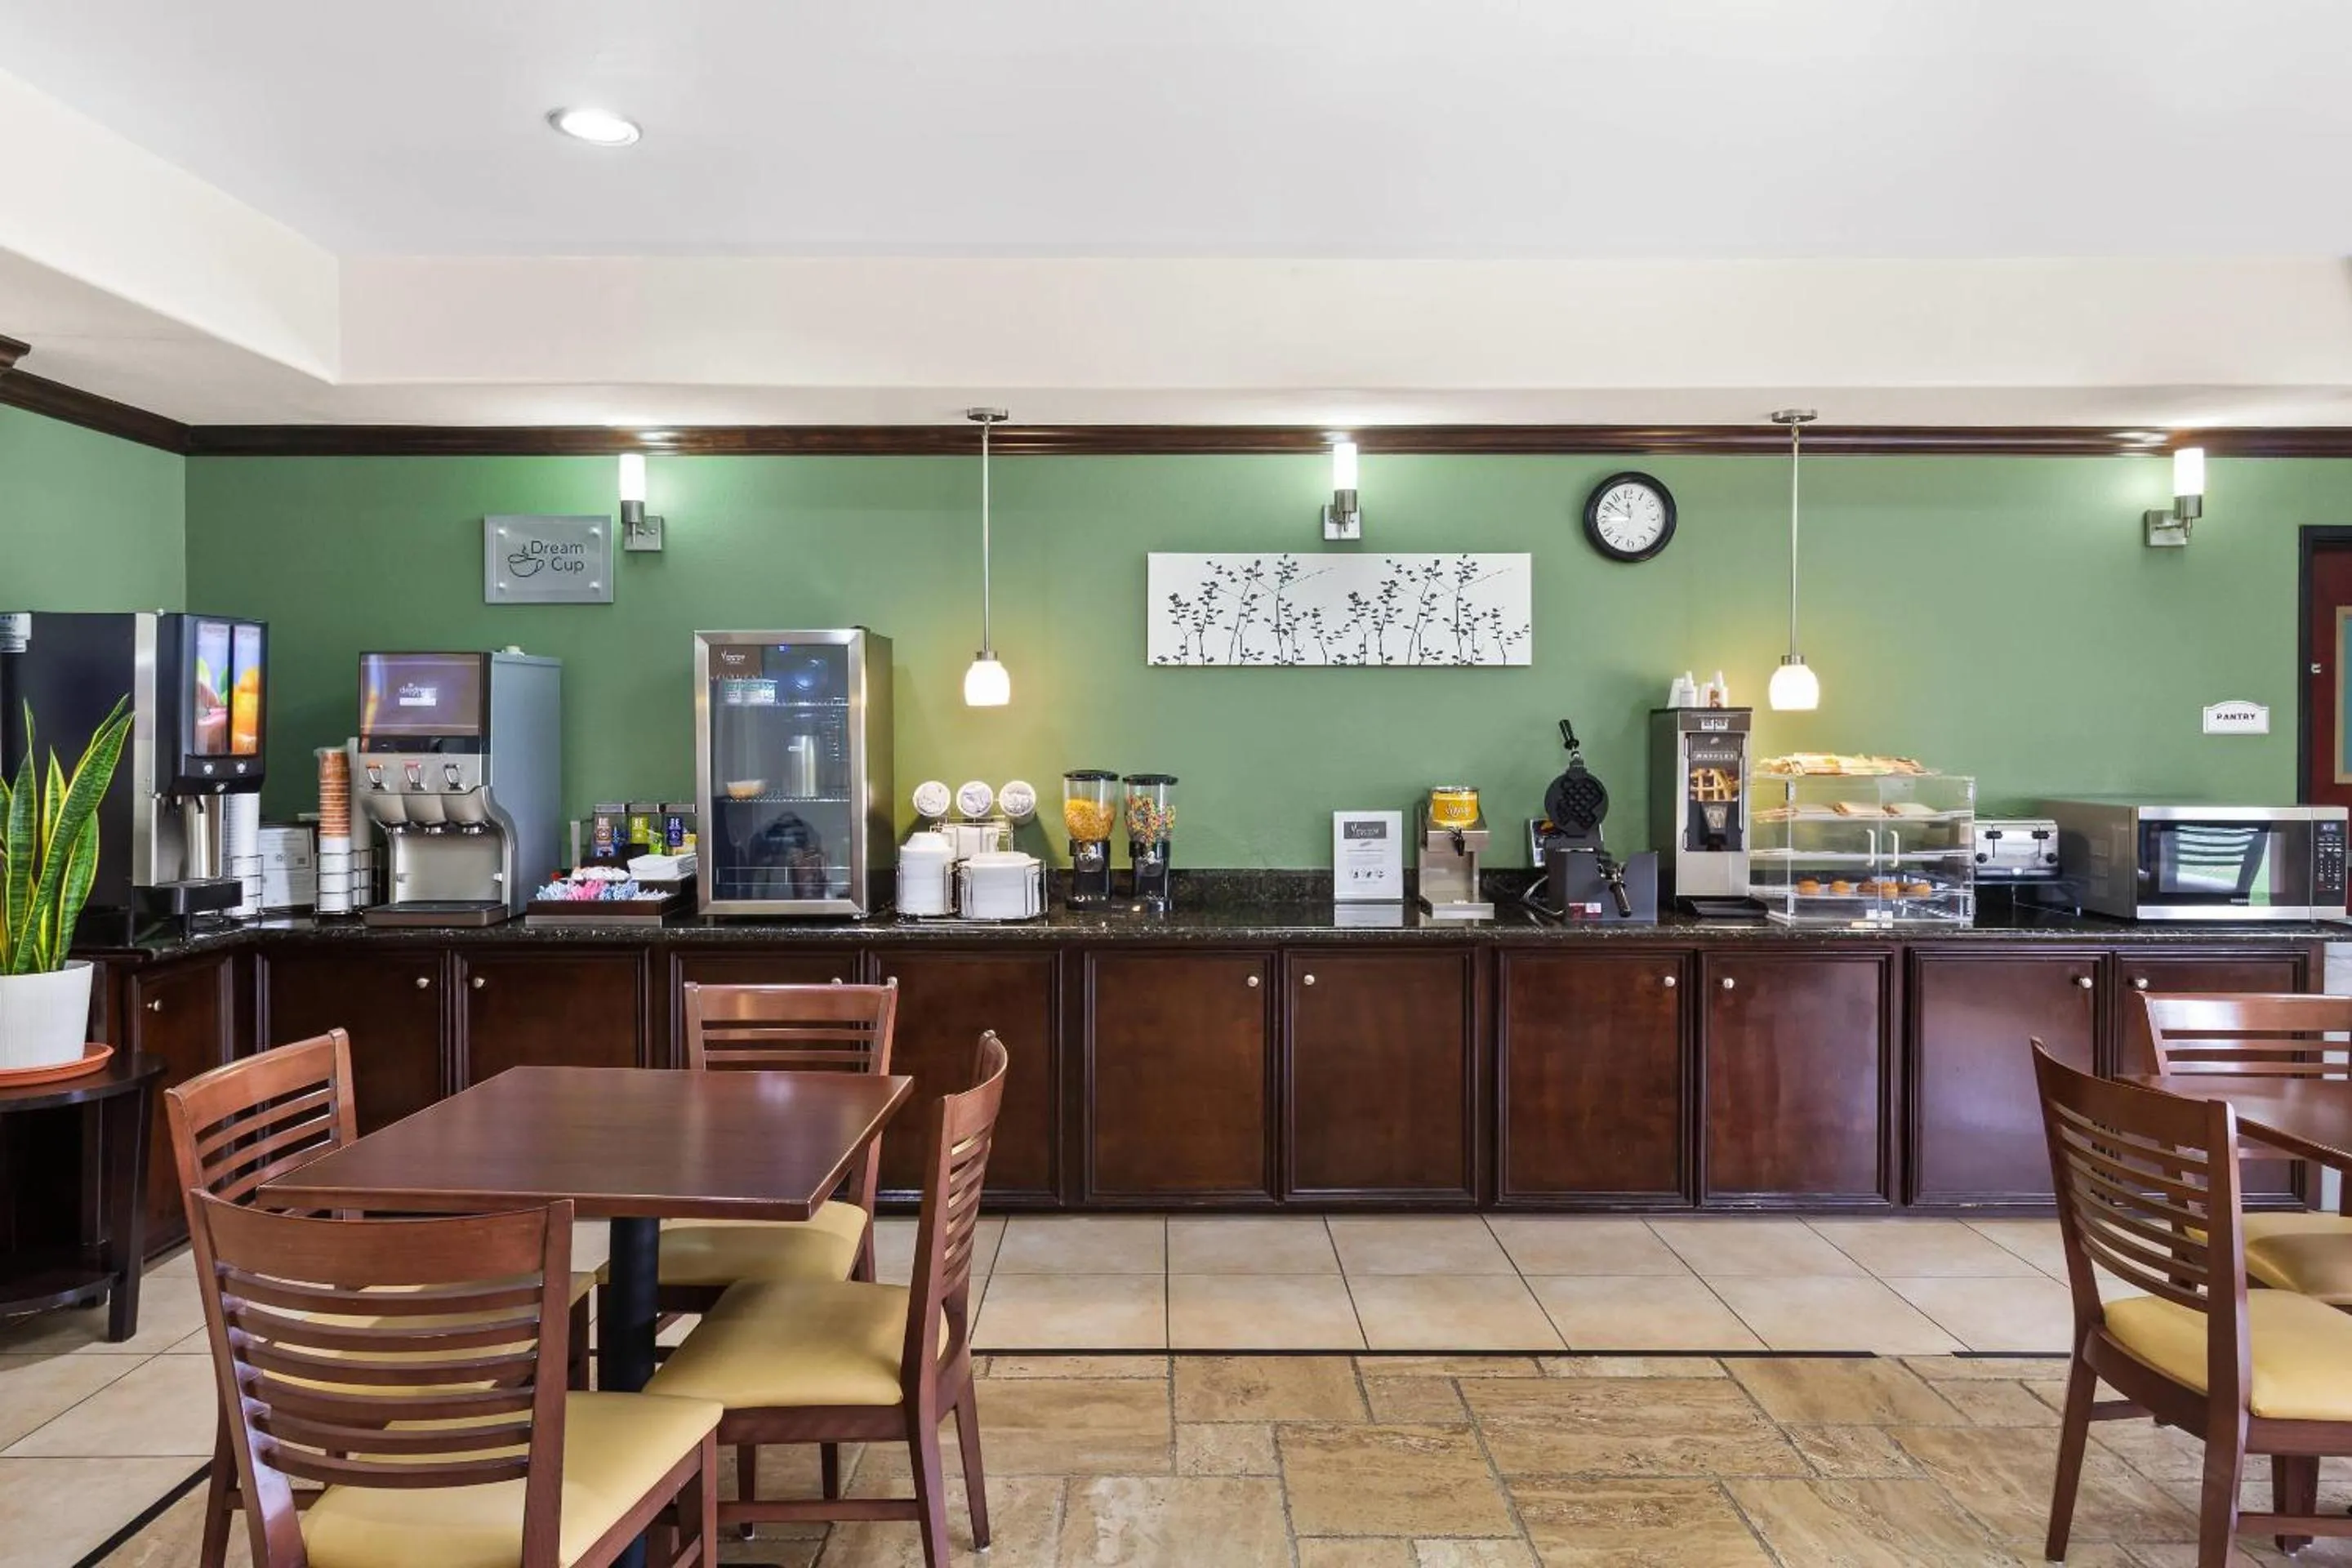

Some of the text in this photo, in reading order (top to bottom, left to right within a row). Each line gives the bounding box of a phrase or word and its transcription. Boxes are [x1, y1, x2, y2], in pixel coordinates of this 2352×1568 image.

[531, 540, 585, 555] Dream
[550, 556, 585, 574] Cup
[2216, 712, 2256, 720] PANTRY
